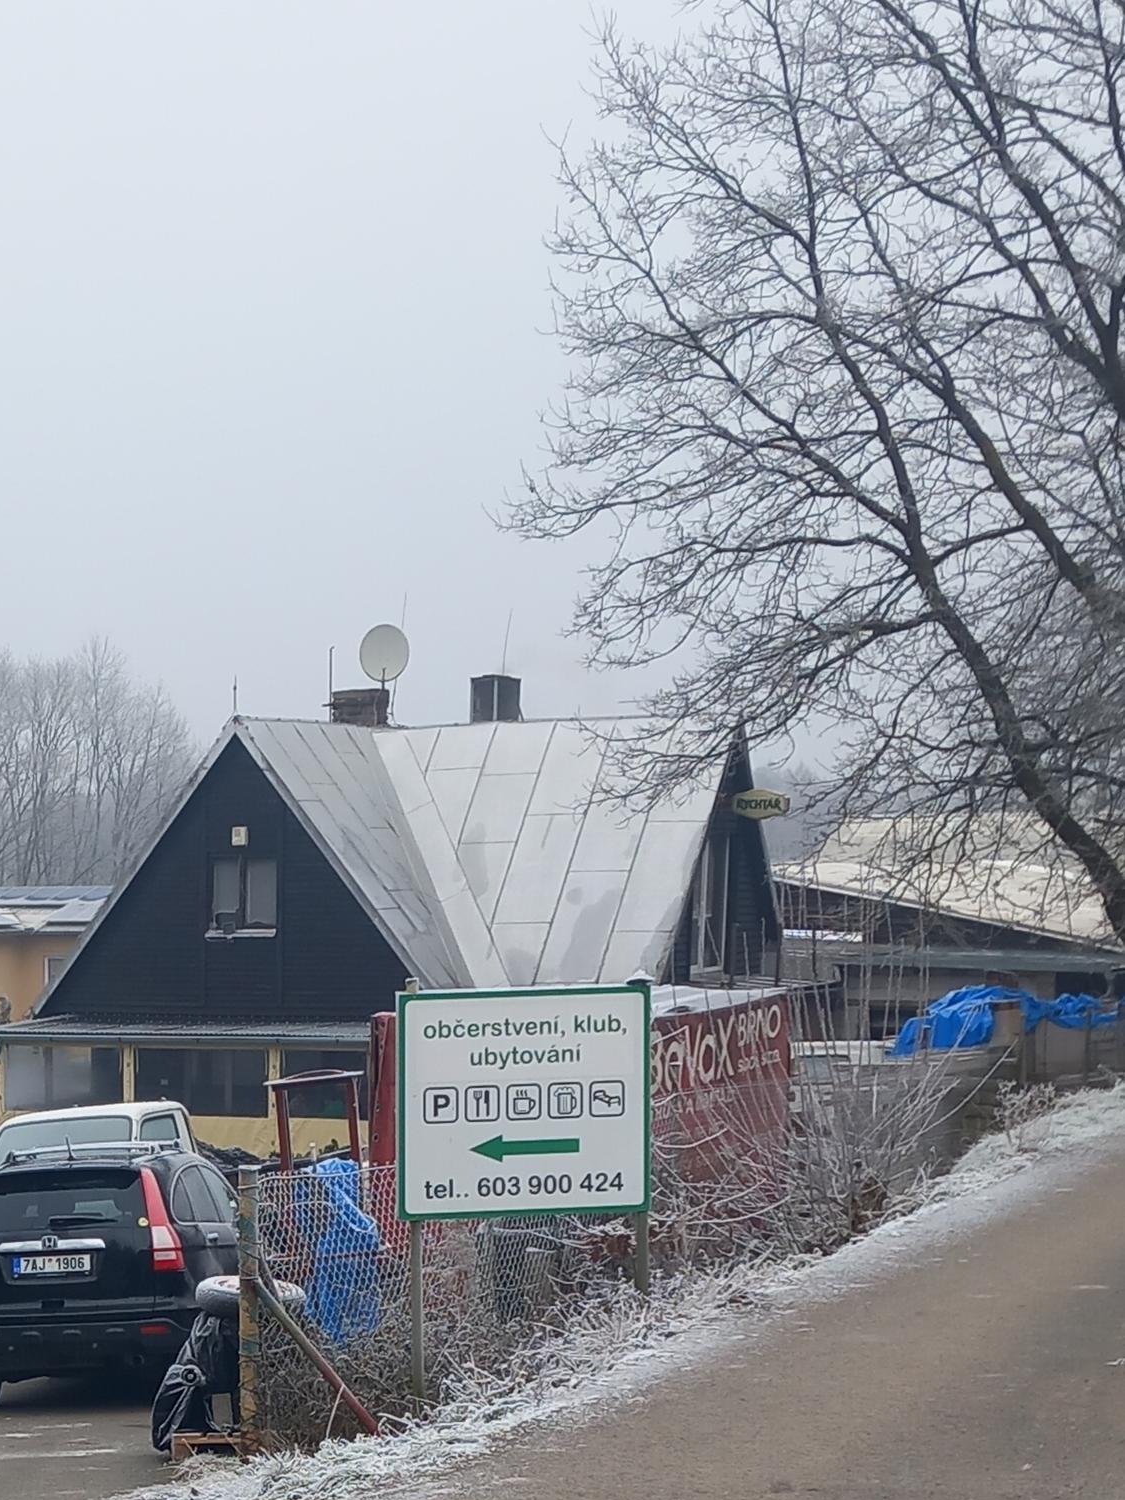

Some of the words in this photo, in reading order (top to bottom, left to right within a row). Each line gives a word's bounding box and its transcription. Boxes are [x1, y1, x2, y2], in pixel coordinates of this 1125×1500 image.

[423, 1015, 566, 1040] občerstvení,
[573, 1013, 627, 1036] klub,
[737, 1005, 781, 1047] BRNO
[469, 1044, 582, 1071] ubytování
[432, 1094, 451, 1118] P
[477, 1176, 521, 1198] 603
[527, 1174, 573, 1196] 900
[579, 1171, 625, 1193] 424
[23, 1258, 46, 1271] 7AJ
[56, 1257, 85, 1270] 1906
